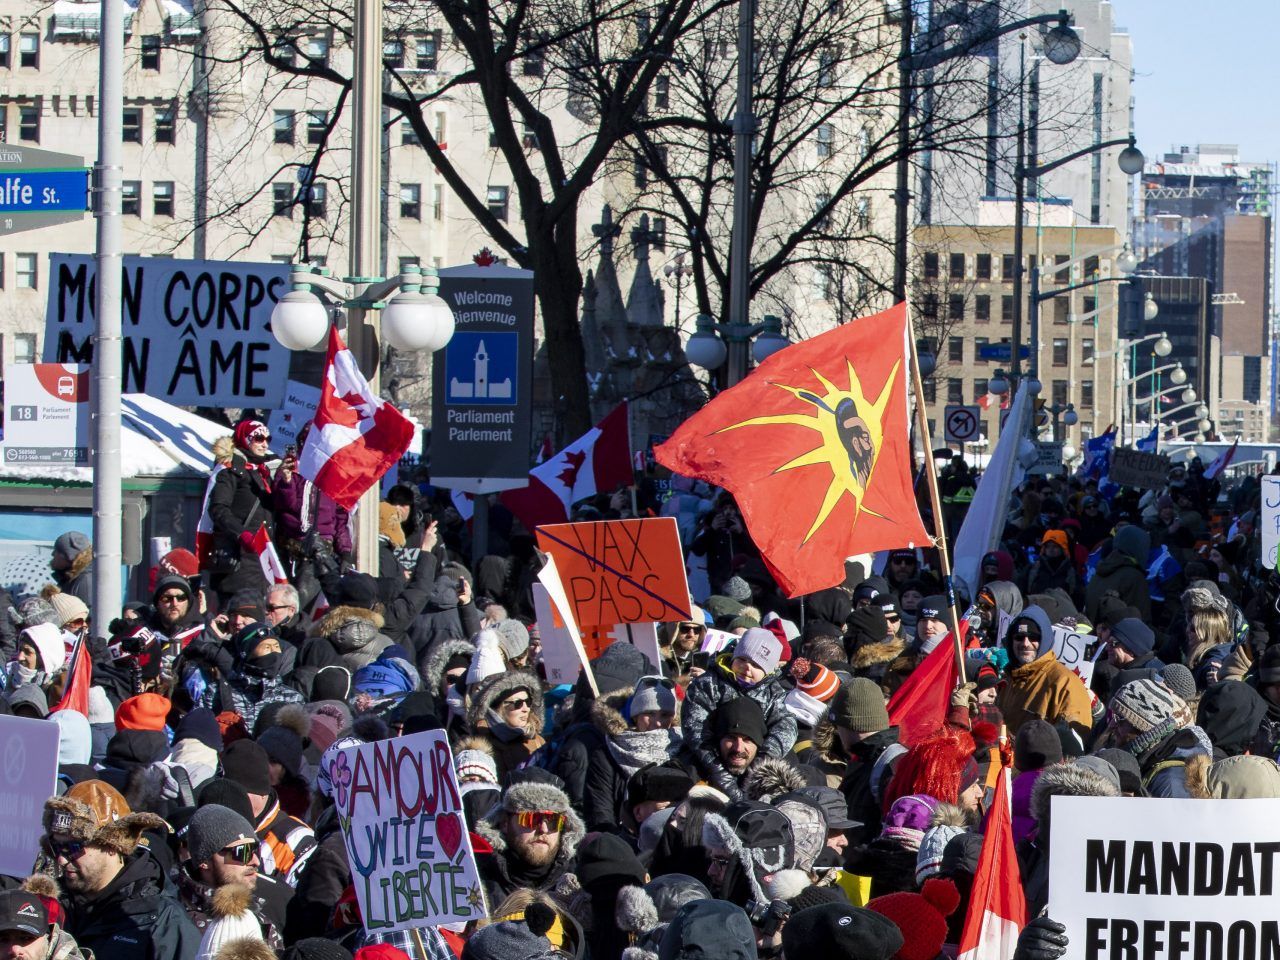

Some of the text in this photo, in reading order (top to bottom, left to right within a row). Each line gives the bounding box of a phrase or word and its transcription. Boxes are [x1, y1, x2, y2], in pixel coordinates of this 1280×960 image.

[42, 187, 60, 204] St.
[58, 263, 144, 325] MN
[454, 290, 513, 307] Welcome
[166, 323, 271, 397] ÂME
[17, 407, 32, 420] 18
[447, 409, 514, 424] Parliament
[449, 427, 512, 442] Parlement
[572, 519, 652, 573] VAX
[570, 573, 667, 627] PASS
[350, 740, 463, 821] AMOUR
[365, 849, 472, 930] LIBERTÉ
